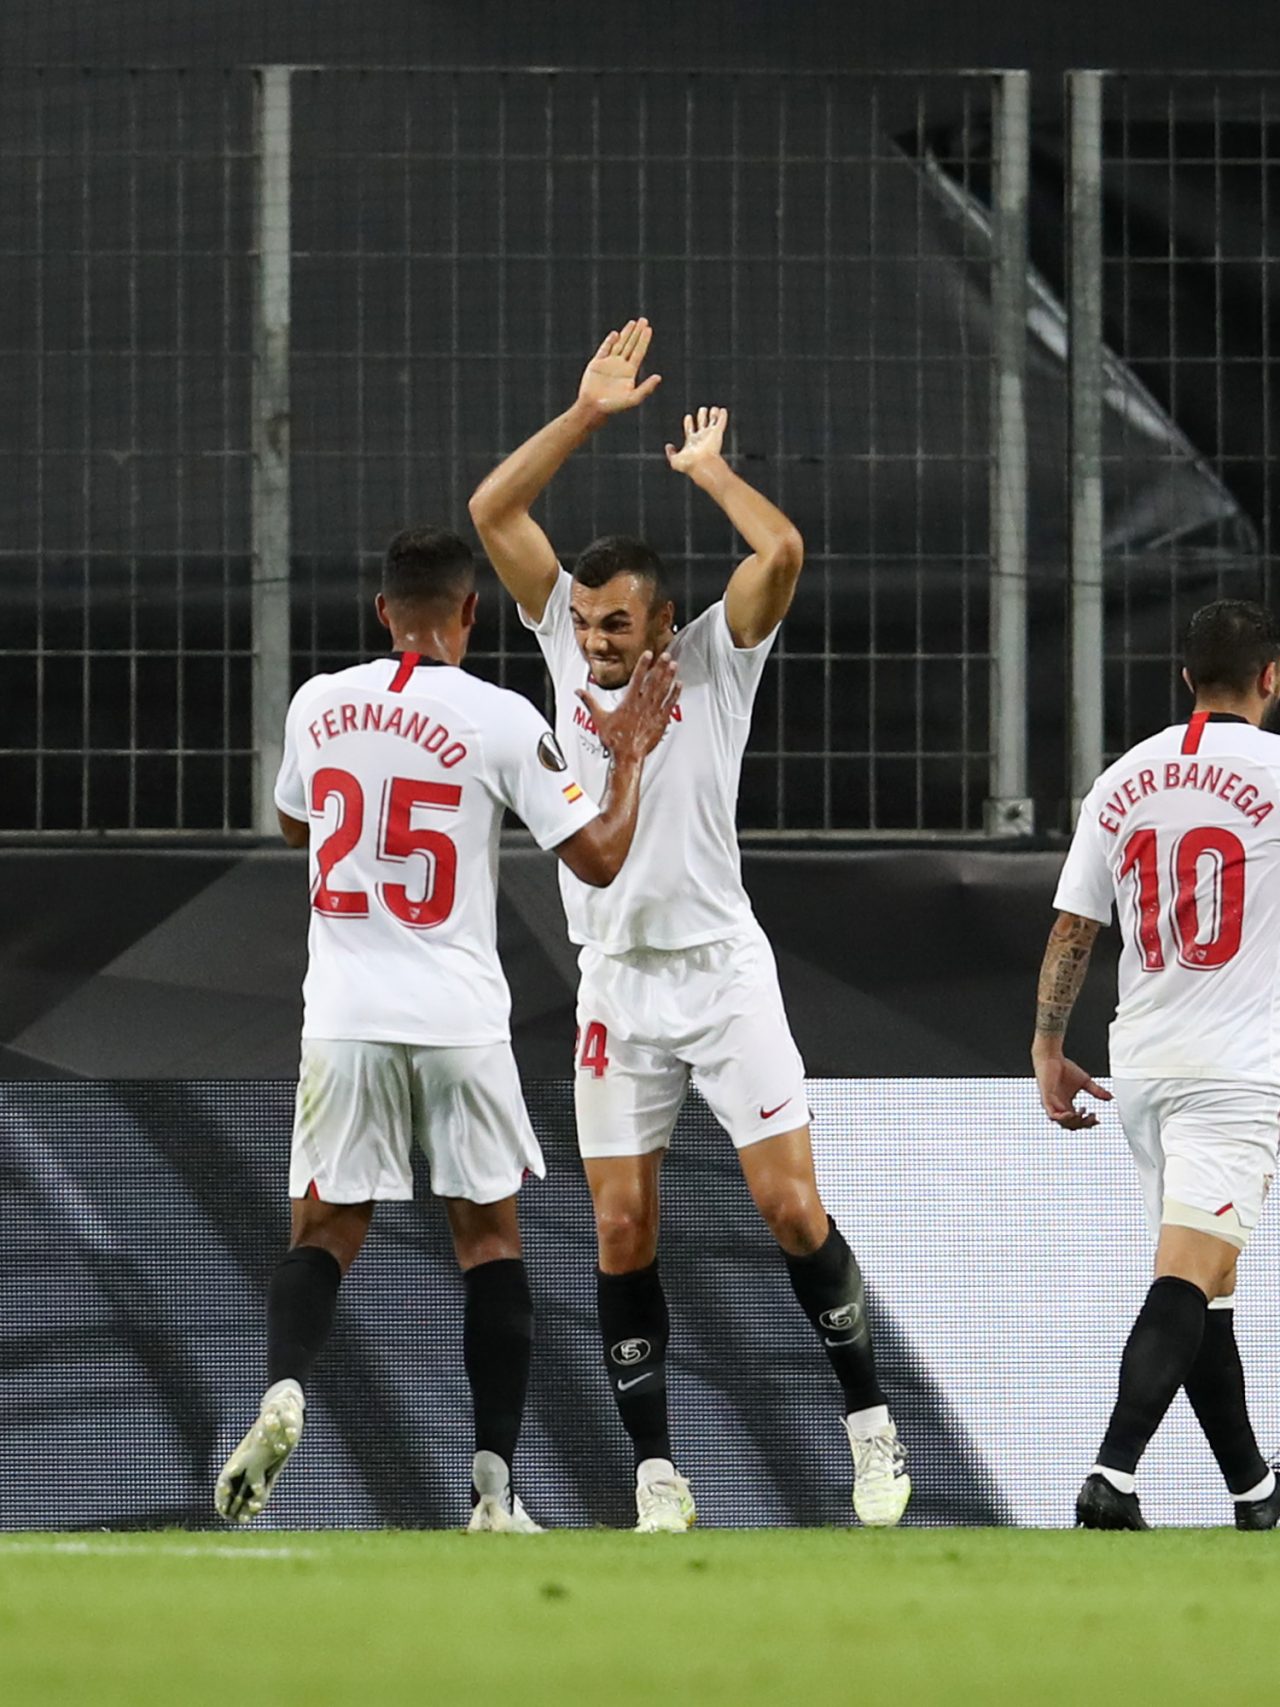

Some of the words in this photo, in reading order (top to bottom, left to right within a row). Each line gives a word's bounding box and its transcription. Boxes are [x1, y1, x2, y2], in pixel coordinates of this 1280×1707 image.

[308, 703, 467, 769] FERNANDO
[310, 767, 463, 930] 25
[1098, 768, 1158, 835] EVER
[1163, 762, 1275, 828] BANEGA
[1117, 826, 1246, 972] 10
